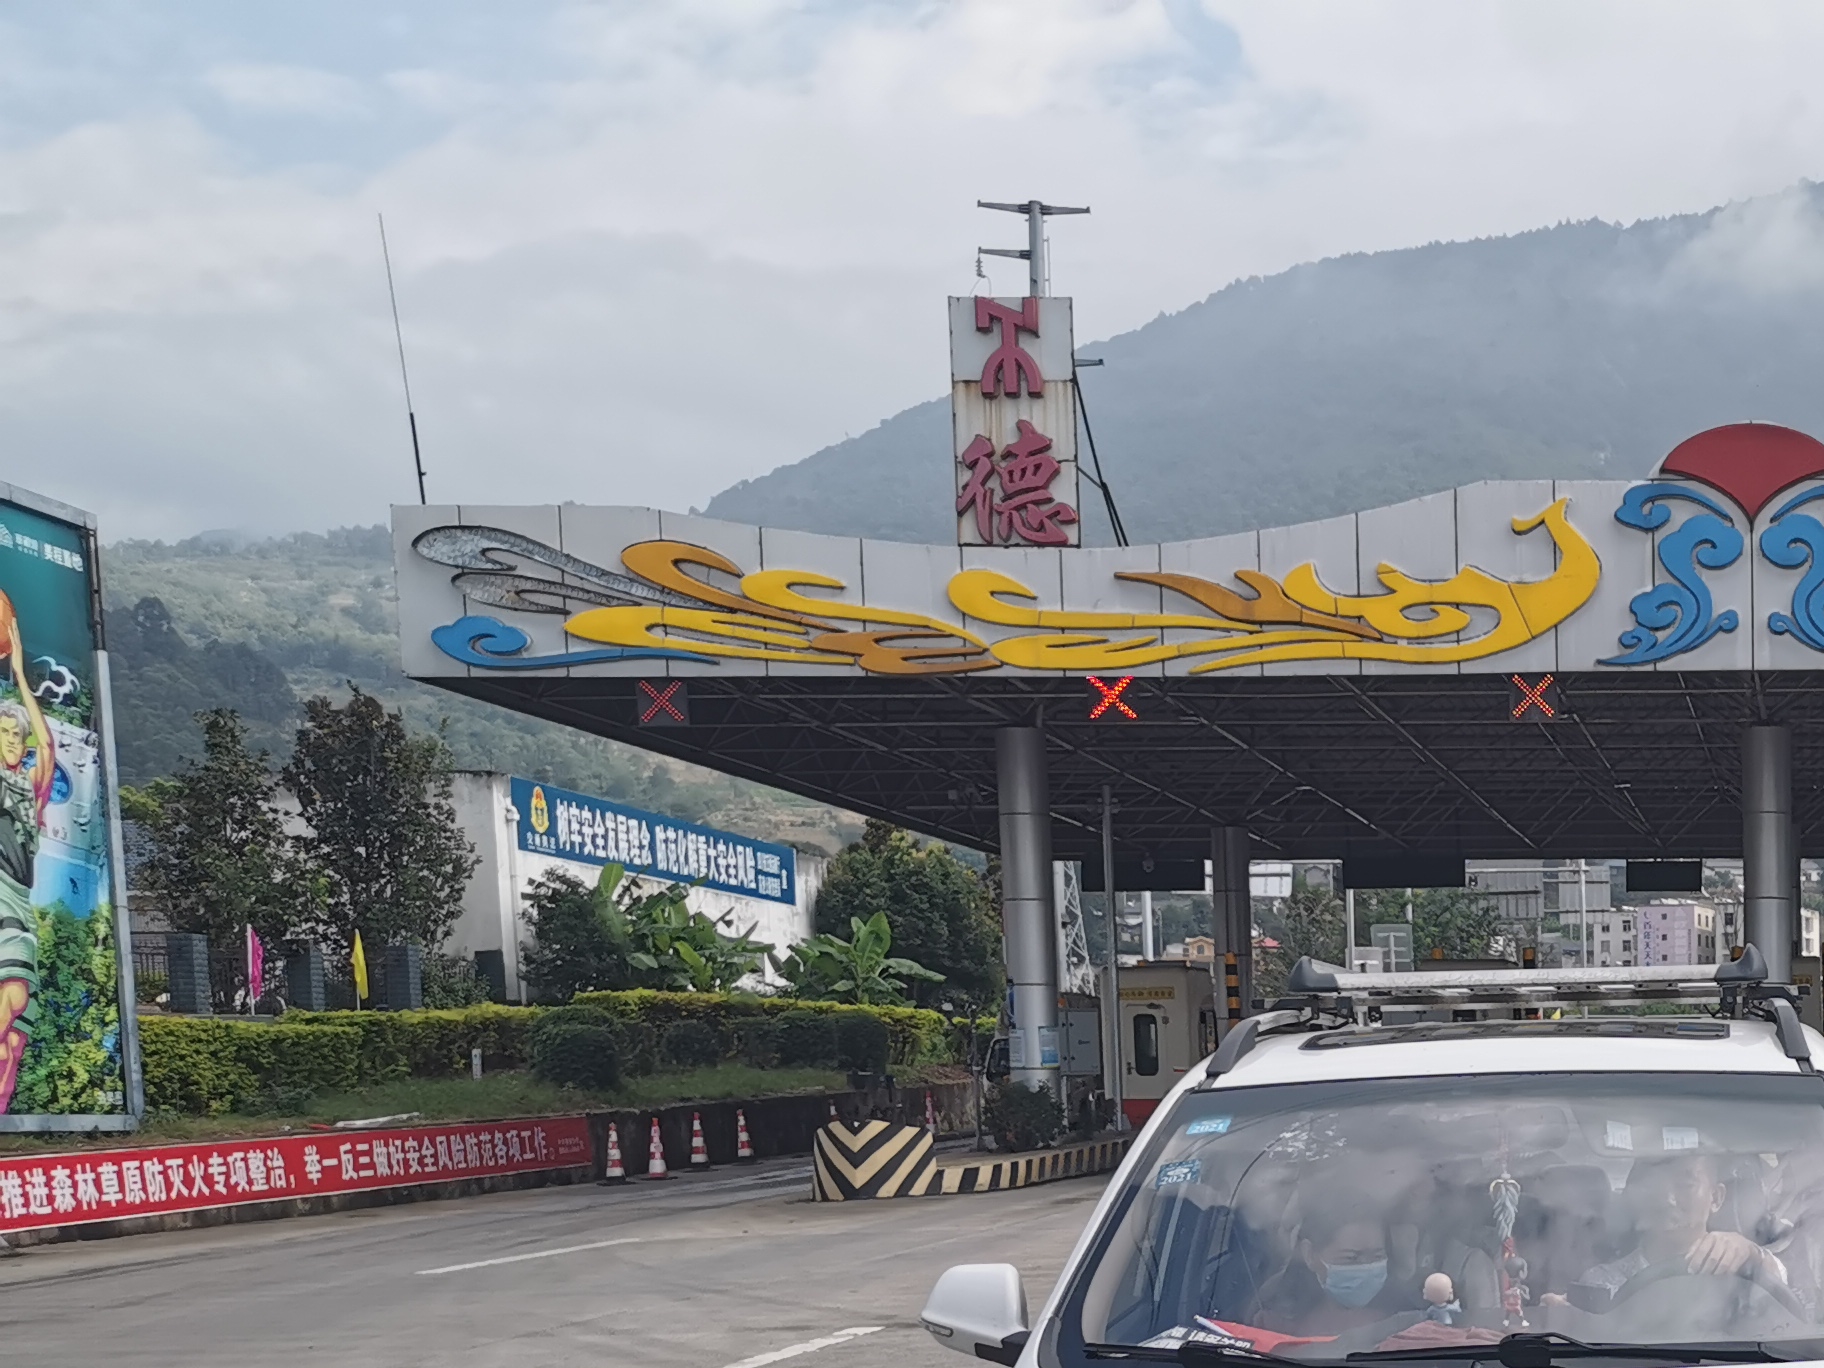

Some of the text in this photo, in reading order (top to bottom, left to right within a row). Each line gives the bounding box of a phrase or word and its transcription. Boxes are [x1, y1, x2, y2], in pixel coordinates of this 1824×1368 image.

[956, 418, 1078, 545] 德
[556, 798, 652, 866] 树牢安全发展理念
